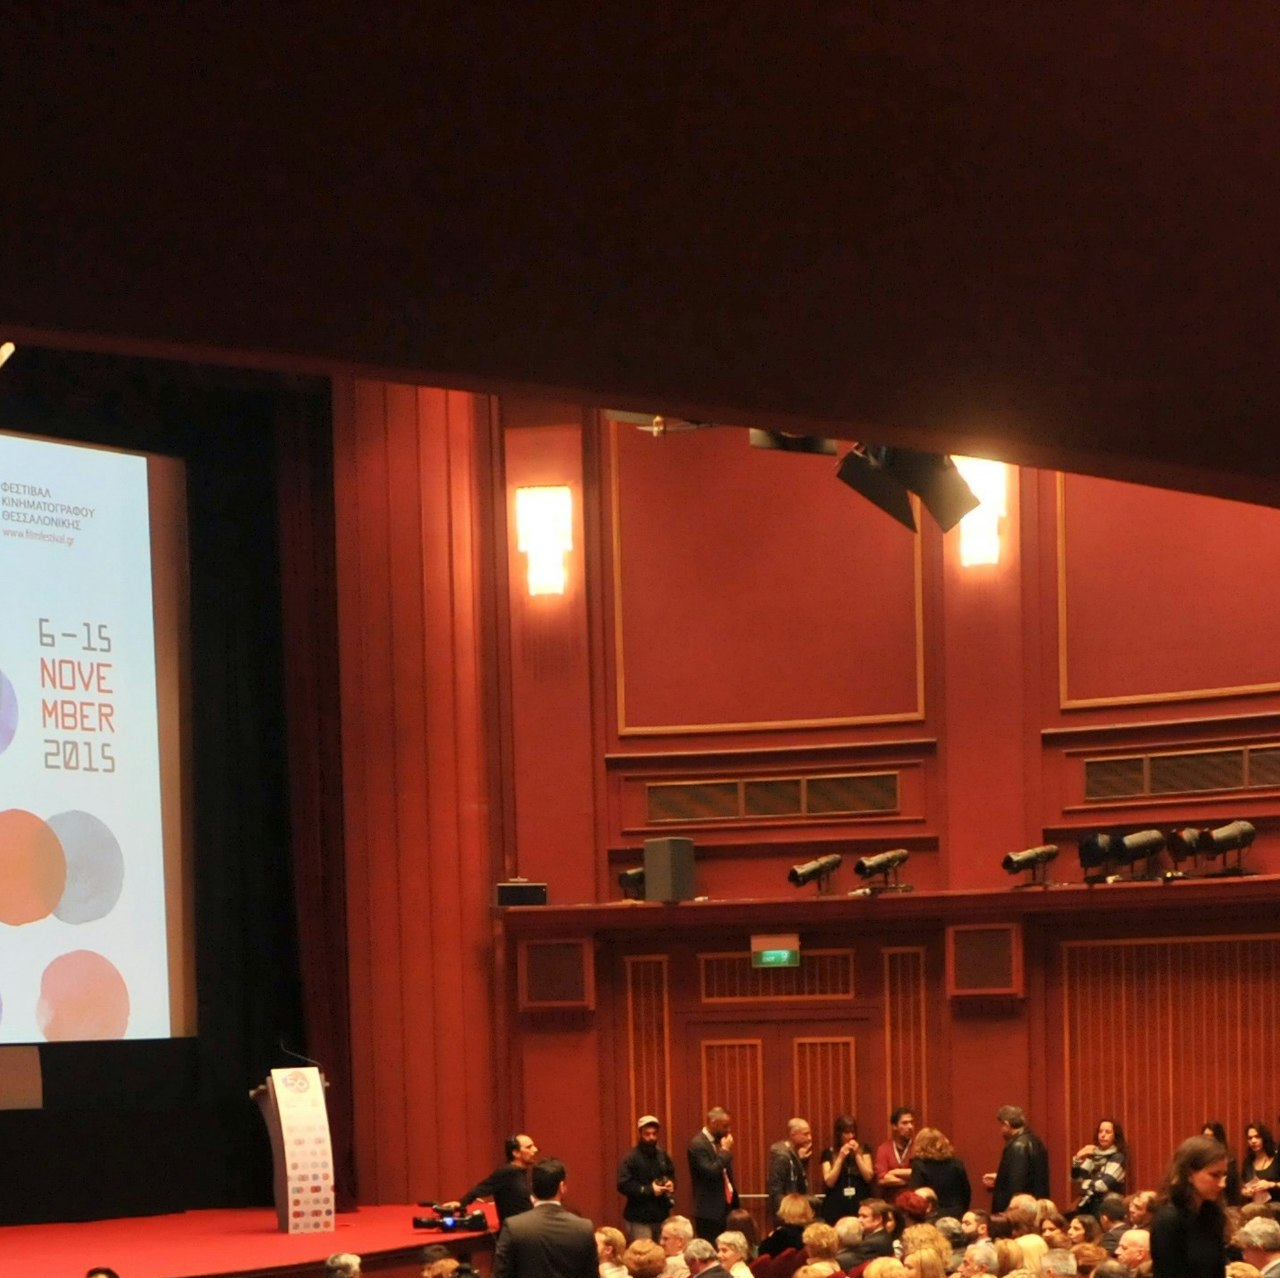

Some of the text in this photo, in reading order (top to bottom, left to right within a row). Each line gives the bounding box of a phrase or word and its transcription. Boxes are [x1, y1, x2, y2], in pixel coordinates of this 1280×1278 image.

[0, 481, 51, 498] ΦΕΣΤΙΒΑΛ
[1, 496, 95, 518] ΚΙΝΗΜΑΤΟΓΡΑΦΟΥ
[2, 510, 82, 530] ΘΕΣΣΑΛΟΝΙΚΗΣ
[38, 617, 112, 653] 6-15
[40, 656, 113, 694] NOVE
[41, 698, 115, 733] MBER
[44, 738, 116, 773] 2015
